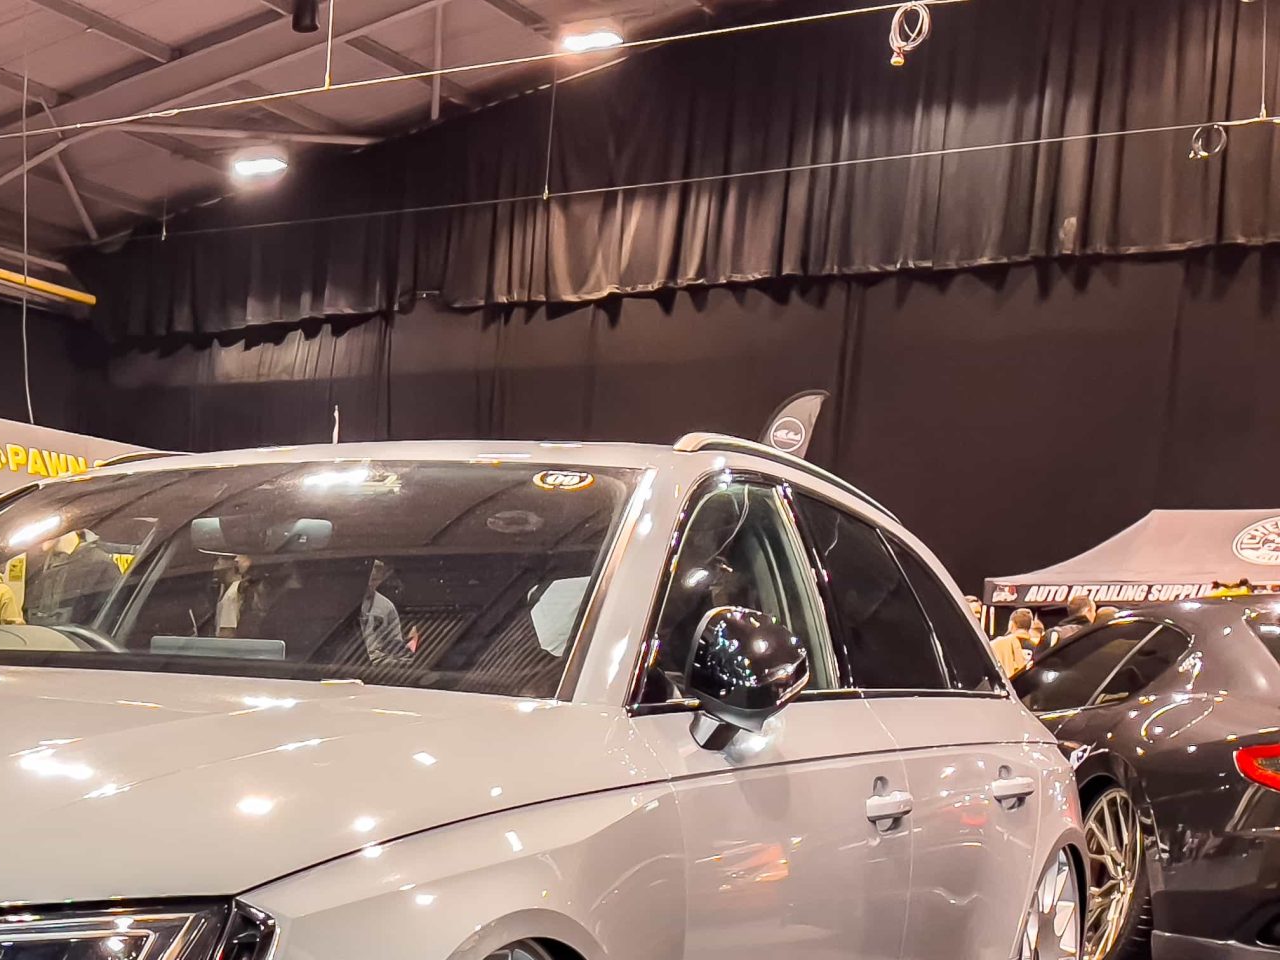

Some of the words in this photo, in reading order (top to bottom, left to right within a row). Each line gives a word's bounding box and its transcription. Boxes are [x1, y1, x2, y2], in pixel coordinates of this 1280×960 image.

[5, 443, 88, 477] PAWN
[1024, 585, 1069, 602] AUTO
[1067, 584, 1149, 602] DETAILING
